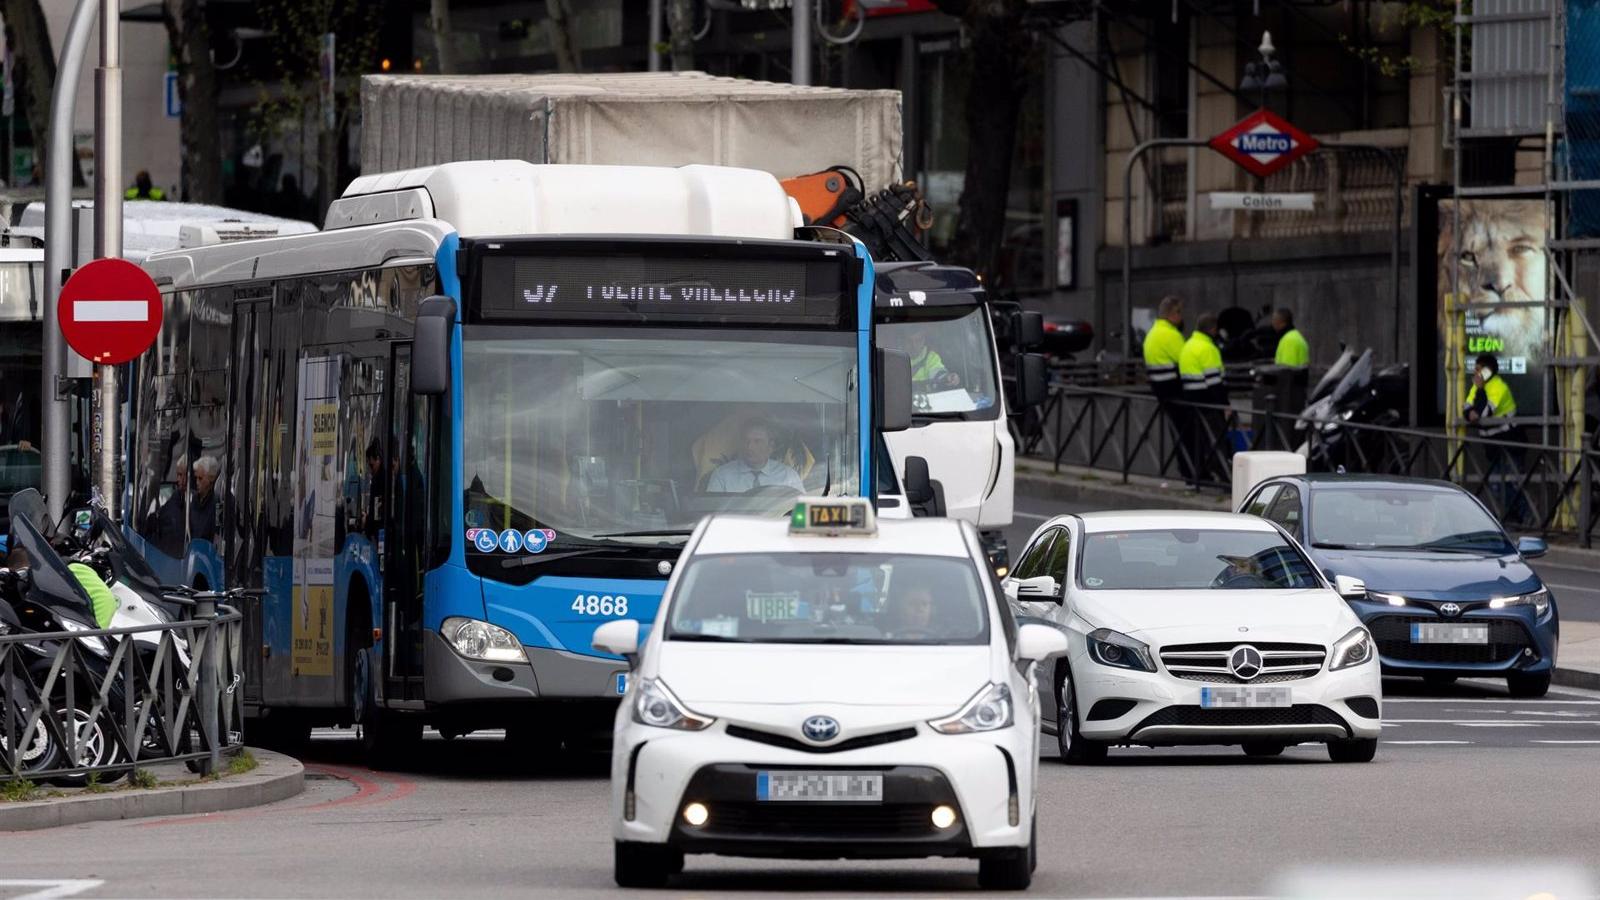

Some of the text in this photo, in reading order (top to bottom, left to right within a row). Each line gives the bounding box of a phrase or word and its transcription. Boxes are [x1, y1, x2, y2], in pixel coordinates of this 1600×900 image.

[1242, 134, 1289, 150] Metro
[1242, 196, 1282, 207] Colón
[811, 507, 847, 522] TAXI
[571, 594, 628, 616] 4868
[749, 599, 796, 618] LIBRE
